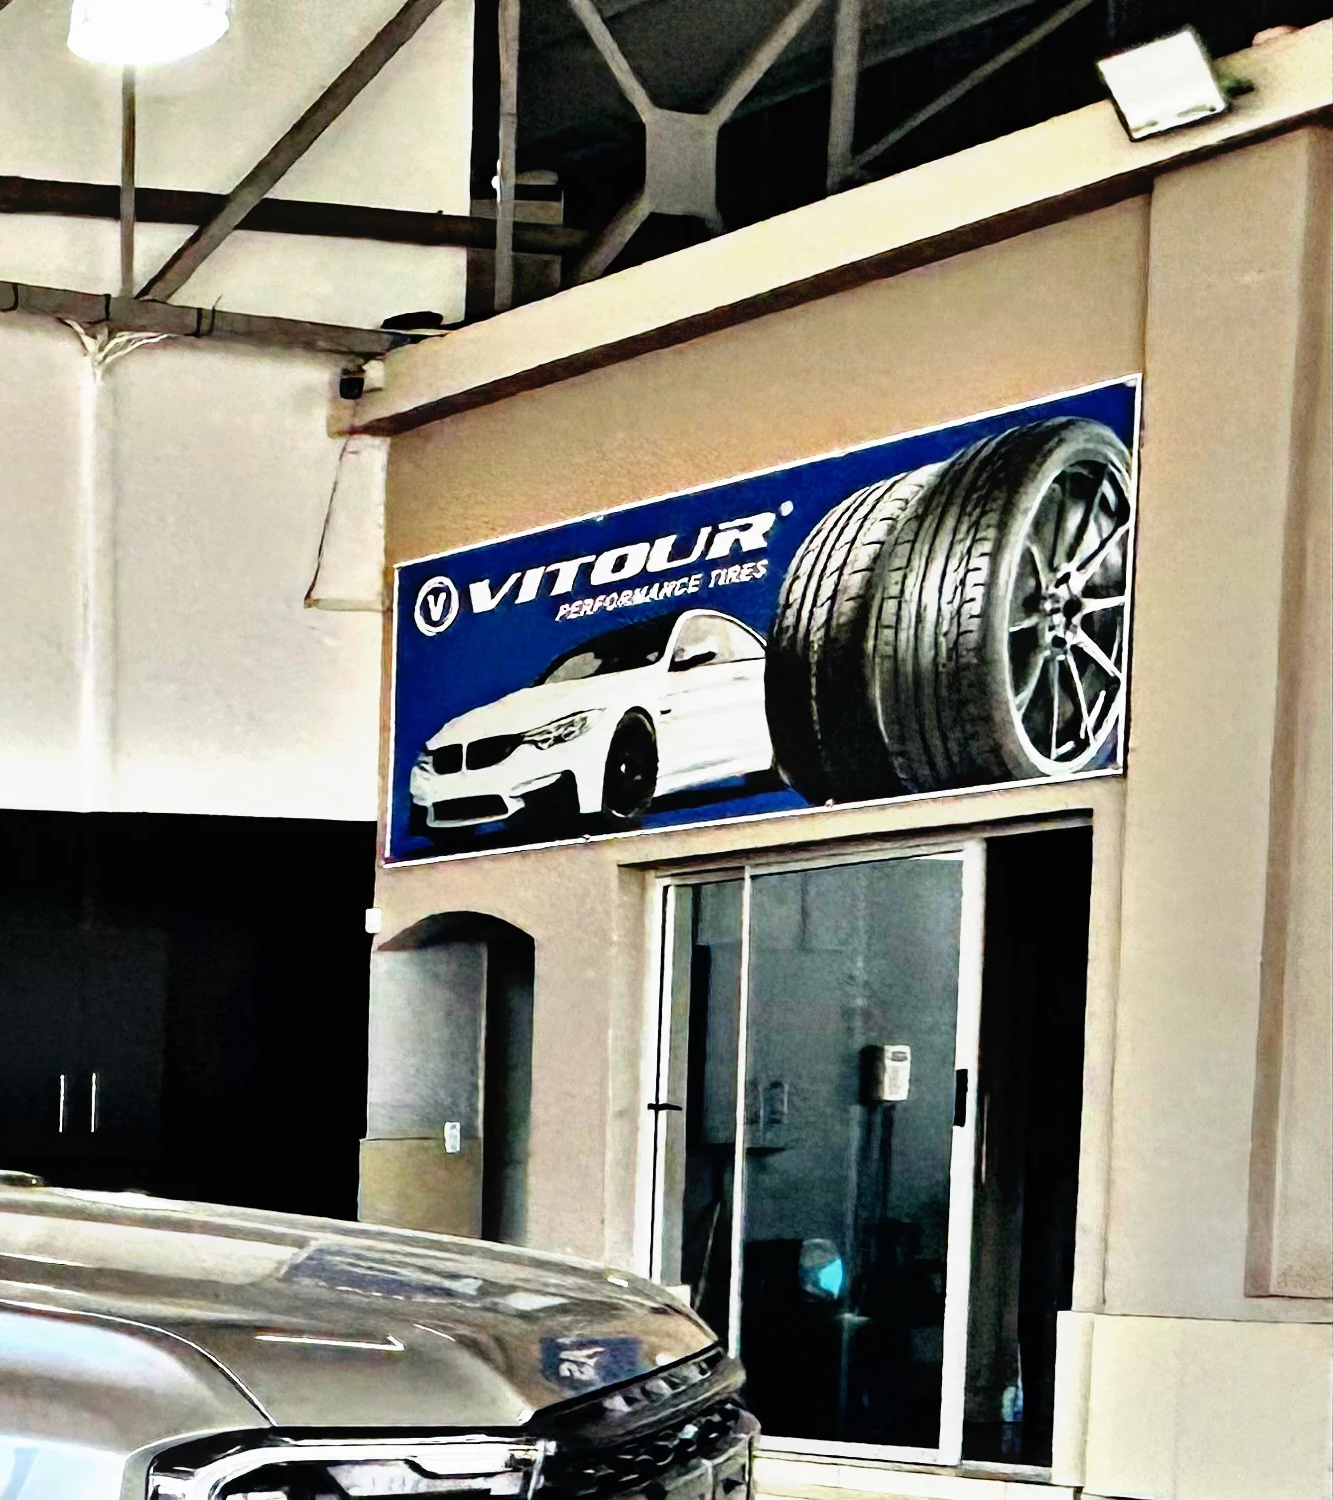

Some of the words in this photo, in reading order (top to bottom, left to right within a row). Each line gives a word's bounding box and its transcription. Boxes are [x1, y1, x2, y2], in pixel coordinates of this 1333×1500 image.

[468, 512, 776, 614] VITOUR
[555, 573, 703, 622] PERFORMANCE
[707, 559, 770, 589] TIRES
